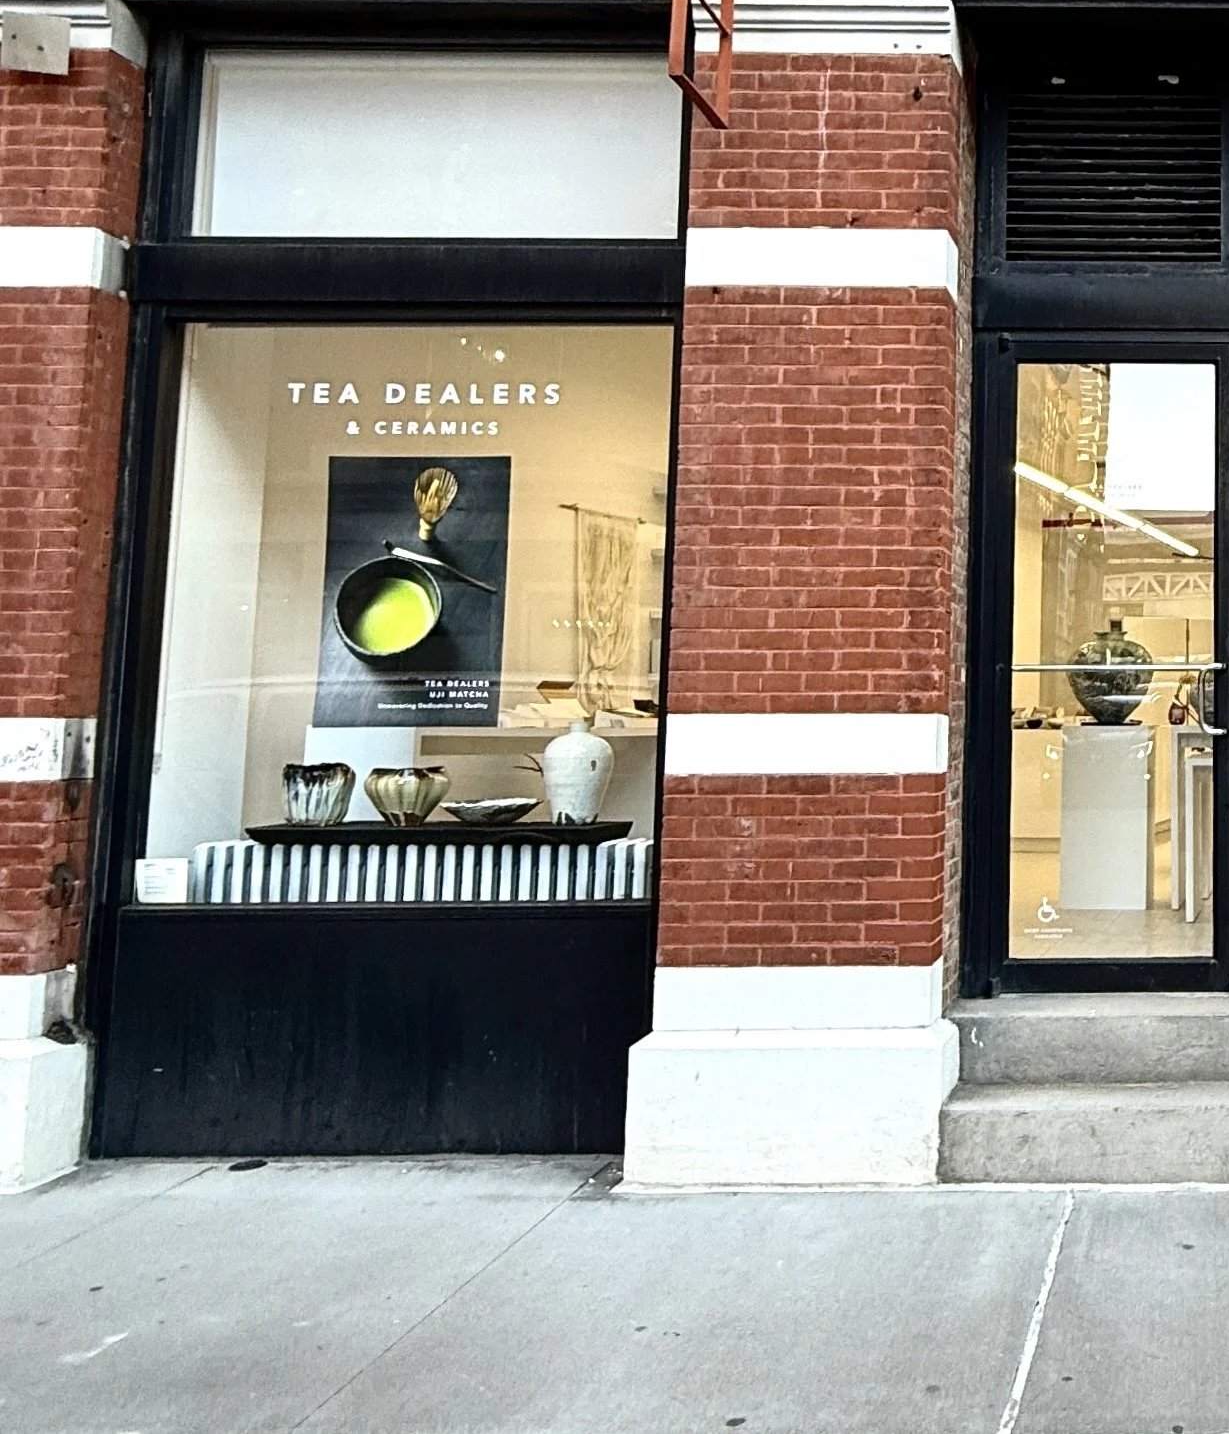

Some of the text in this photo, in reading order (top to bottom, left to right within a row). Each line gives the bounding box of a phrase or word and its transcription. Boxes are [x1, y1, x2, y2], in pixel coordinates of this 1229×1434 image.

[287, 382, 561, 405] TEA DEALERS
[346, 420, 499, 436] & CERAMICS
[424, 679, 490, 688] TEA DEALERS
[429, 690, 489, 699] UJI MATCHA
[463, 701, 489, 710] Quality
